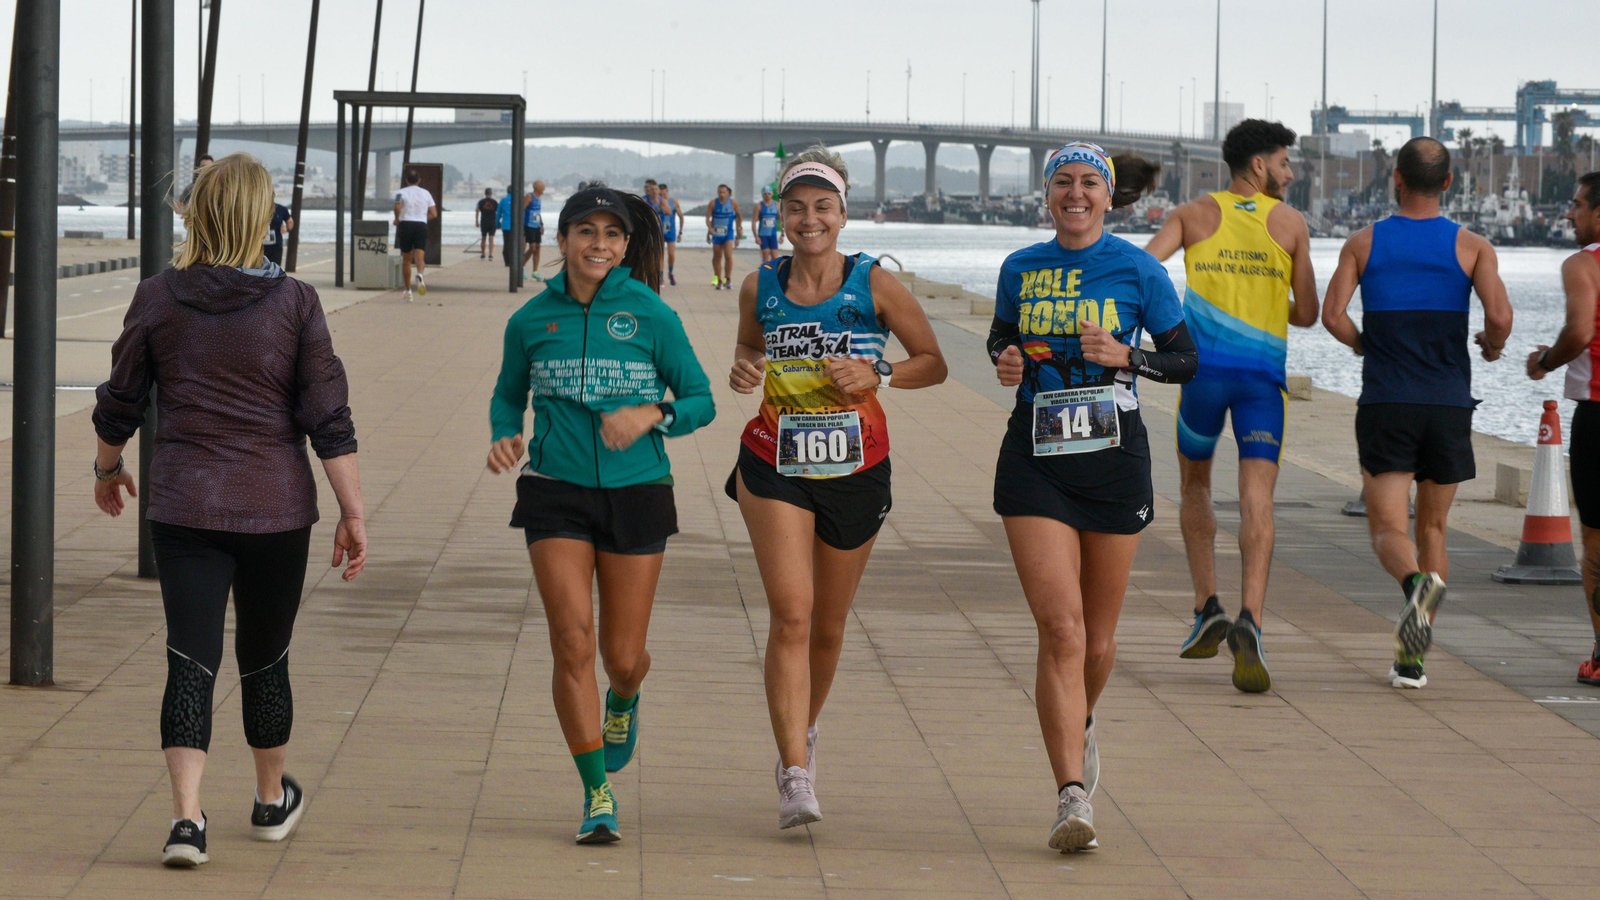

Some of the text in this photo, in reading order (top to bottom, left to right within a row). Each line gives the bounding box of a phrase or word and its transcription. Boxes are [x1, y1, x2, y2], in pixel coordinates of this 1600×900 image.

[1218, 249, 1268, 262] ATLETISMO
[1224, 263, 1237, 274] DE
[1018, 298, 1121, 335] RONDA
[778, 325, 818, 343] TRAIL
[773, 343, 809, 359] TEAM
[588, 358, 596, 368] LA
[597, 358, 620, 369] HIGUERA
[783, 364, 813, 373] Gabarras
[815, 364, 821, 372] &
[588, 367, 596, 377] DE
[598, 368, 607, 379] LA
[608, 369, 624, 379] MIEL
[1054, 390, 1079, 398] CARRERA
[1079, 388, 1104, 396] POPULAR
[826, 413, 850, 421] POPULAR
[1057, 405, 1092, 439] 14
[792, 429, 848, 463] 160
